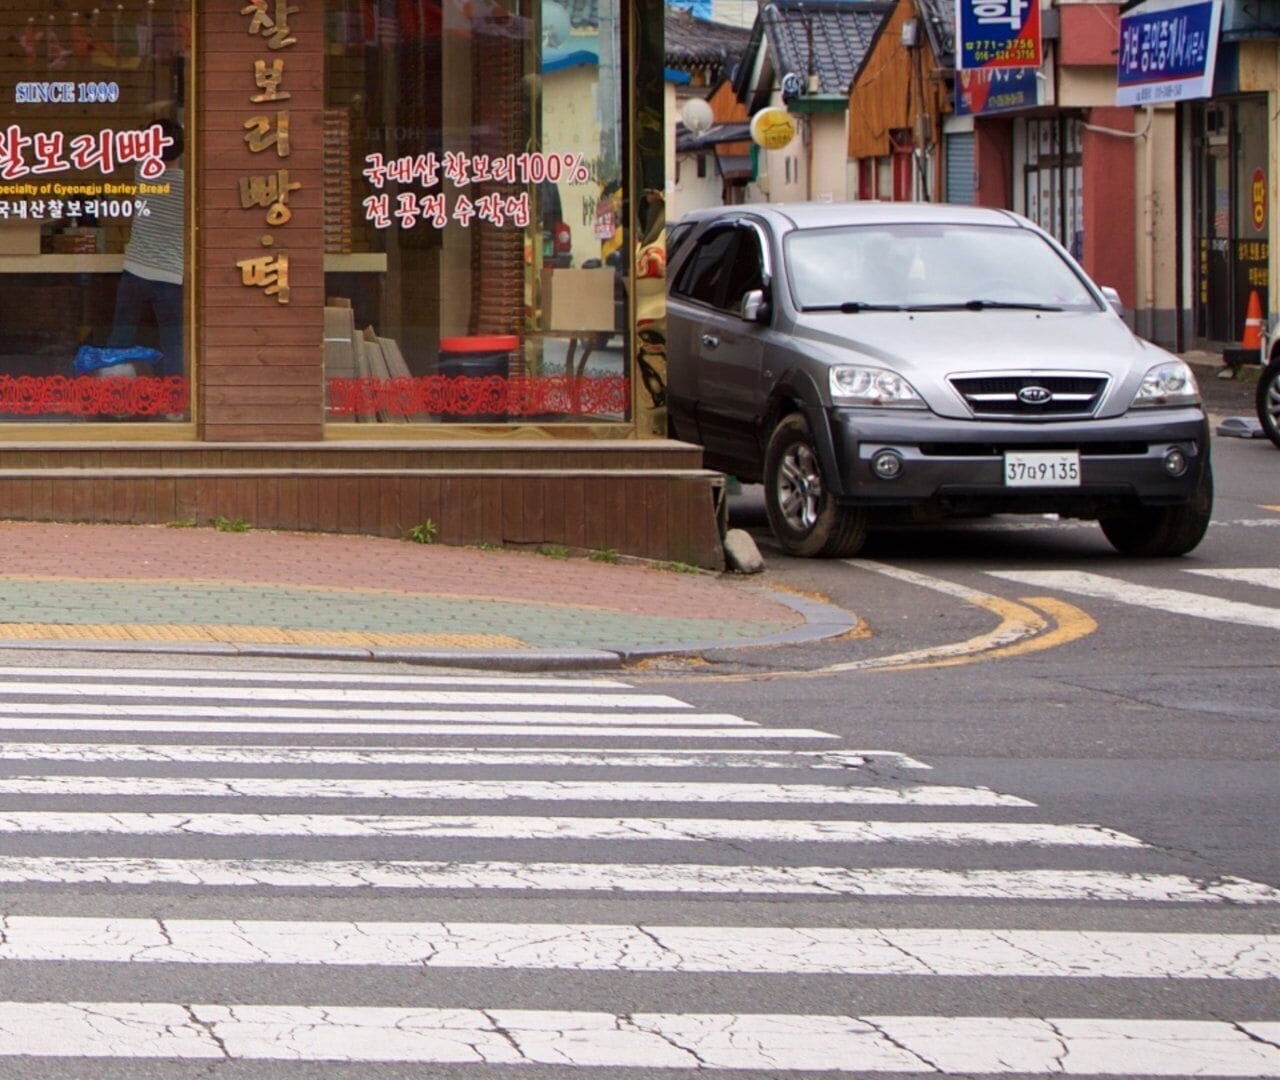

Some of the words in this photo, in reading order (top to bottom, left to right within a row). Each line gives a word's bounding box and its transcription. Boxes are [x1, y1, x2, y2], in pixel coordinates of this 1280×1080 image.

[16, 82, 75, 103] SINCE
[78, 82, 120, 103] 1999
[40, 183, 52, 195] of
[53, 183, 102, 196] Gyeongju
[104, 183, 137, 196] Barley
[139, 183, 171, 195] Bread
